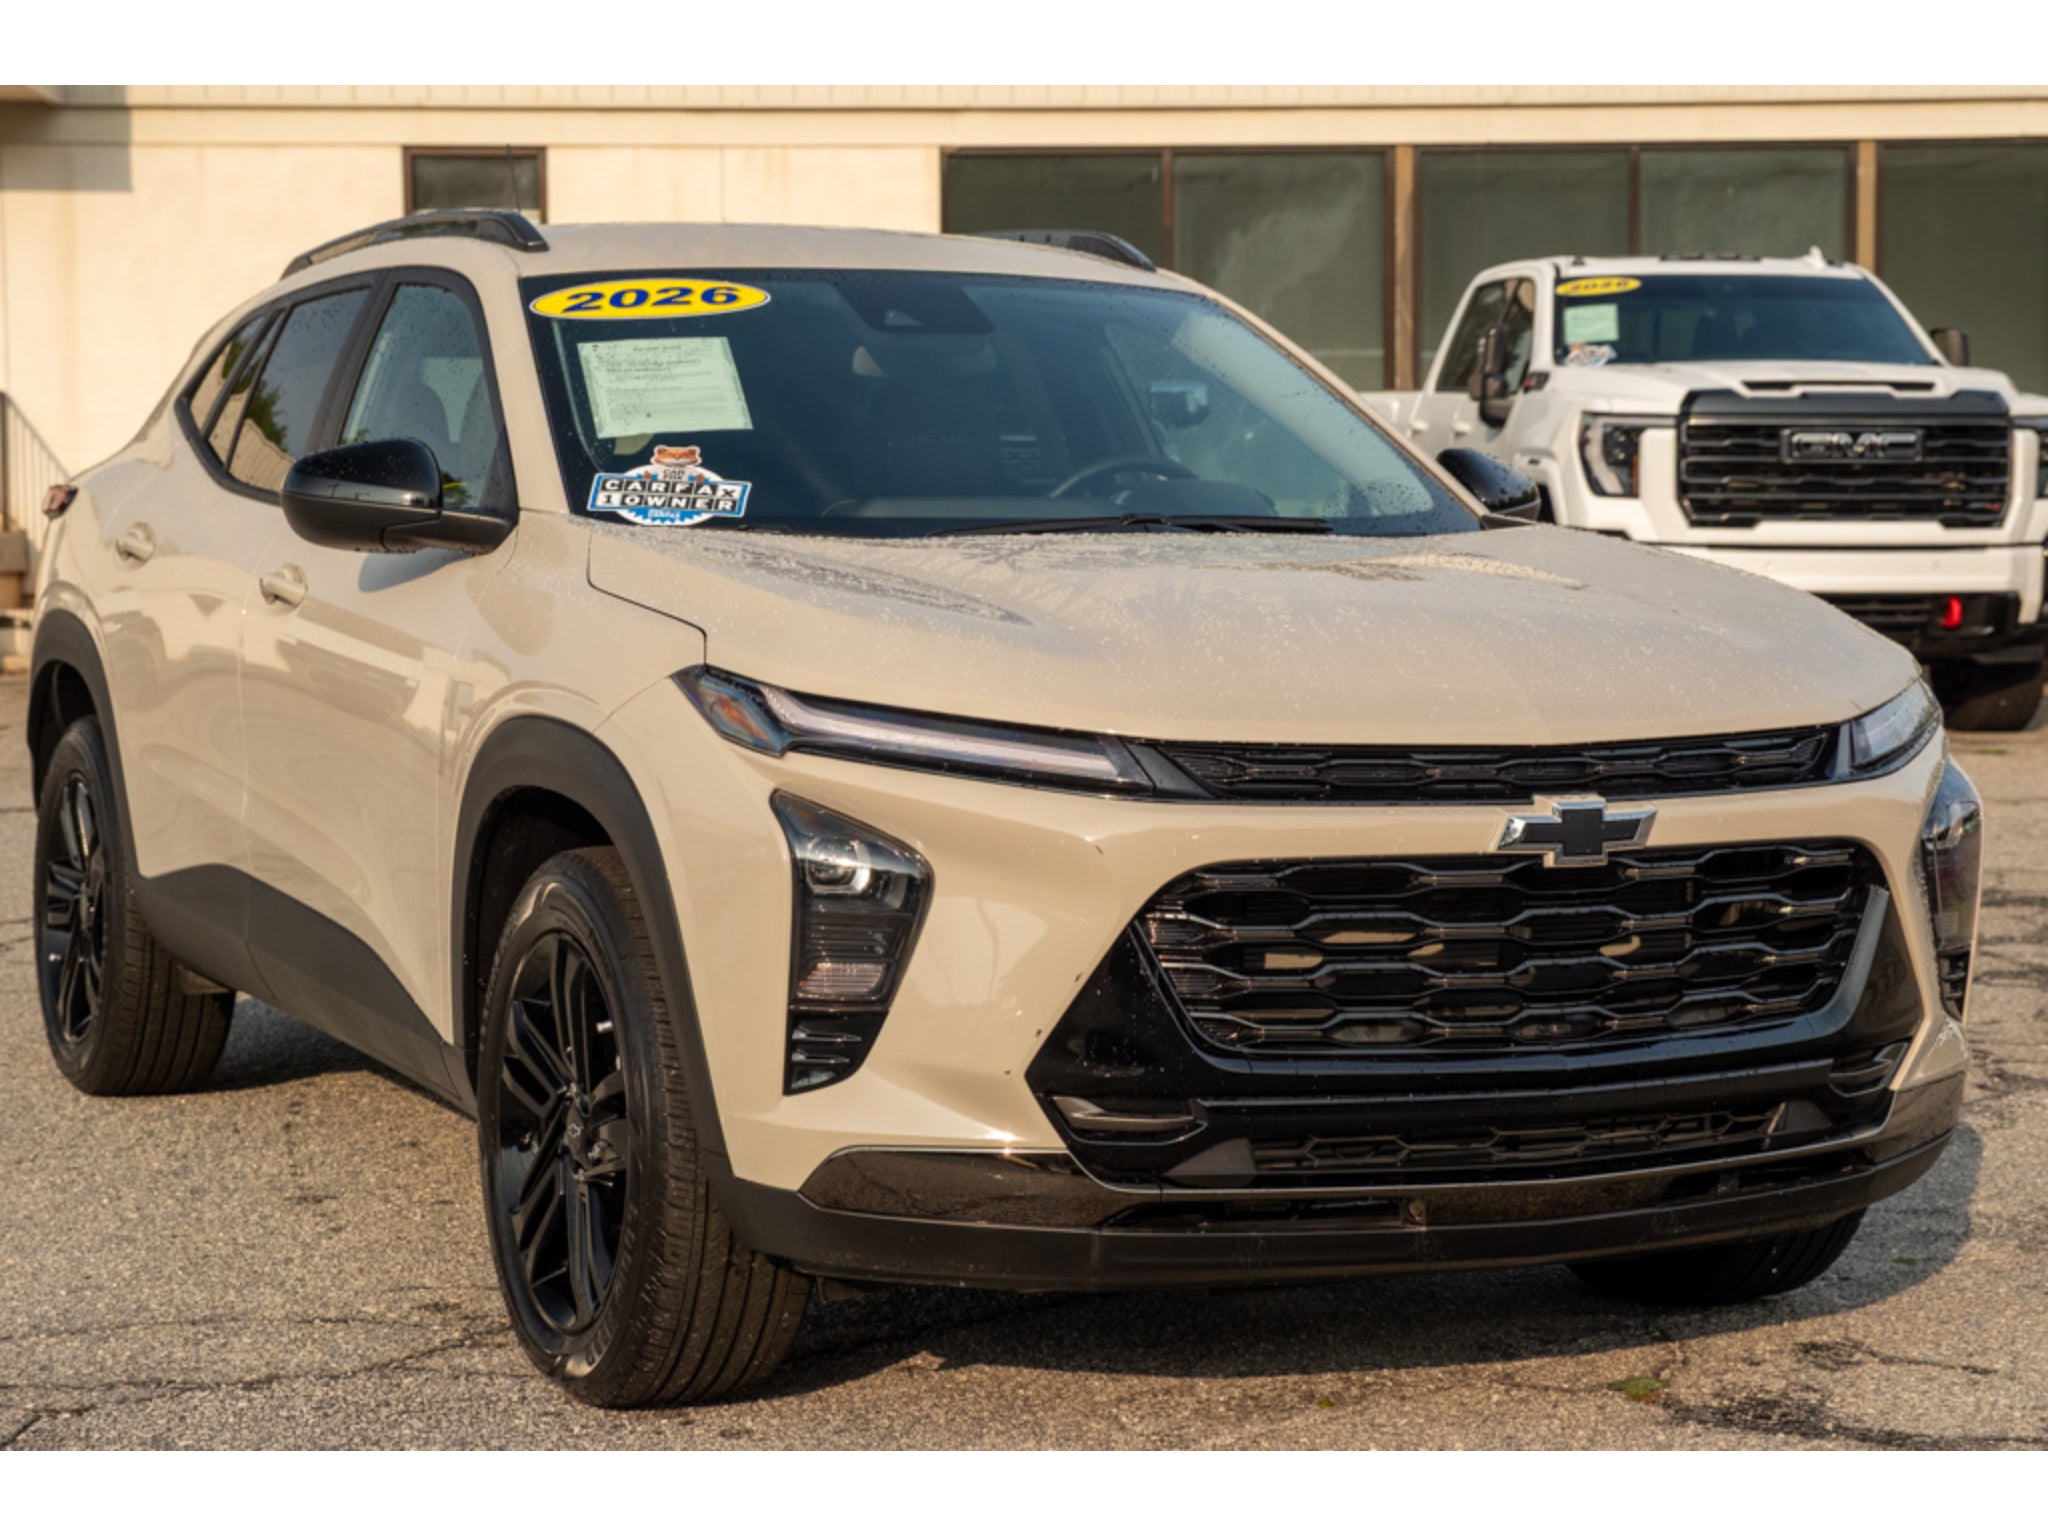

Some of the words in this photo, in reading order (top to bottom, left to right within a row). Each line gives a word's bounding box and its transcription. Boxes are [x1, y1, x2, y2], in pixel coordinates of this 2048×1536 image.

[562, 286, 740, 313] 2026
[1791, 432, 1917, 459] GMC
[604, 479, 738, 498] CARFAX
[602, 494, 614, 505] 1
[624, 495, 733, 511] OWNER
